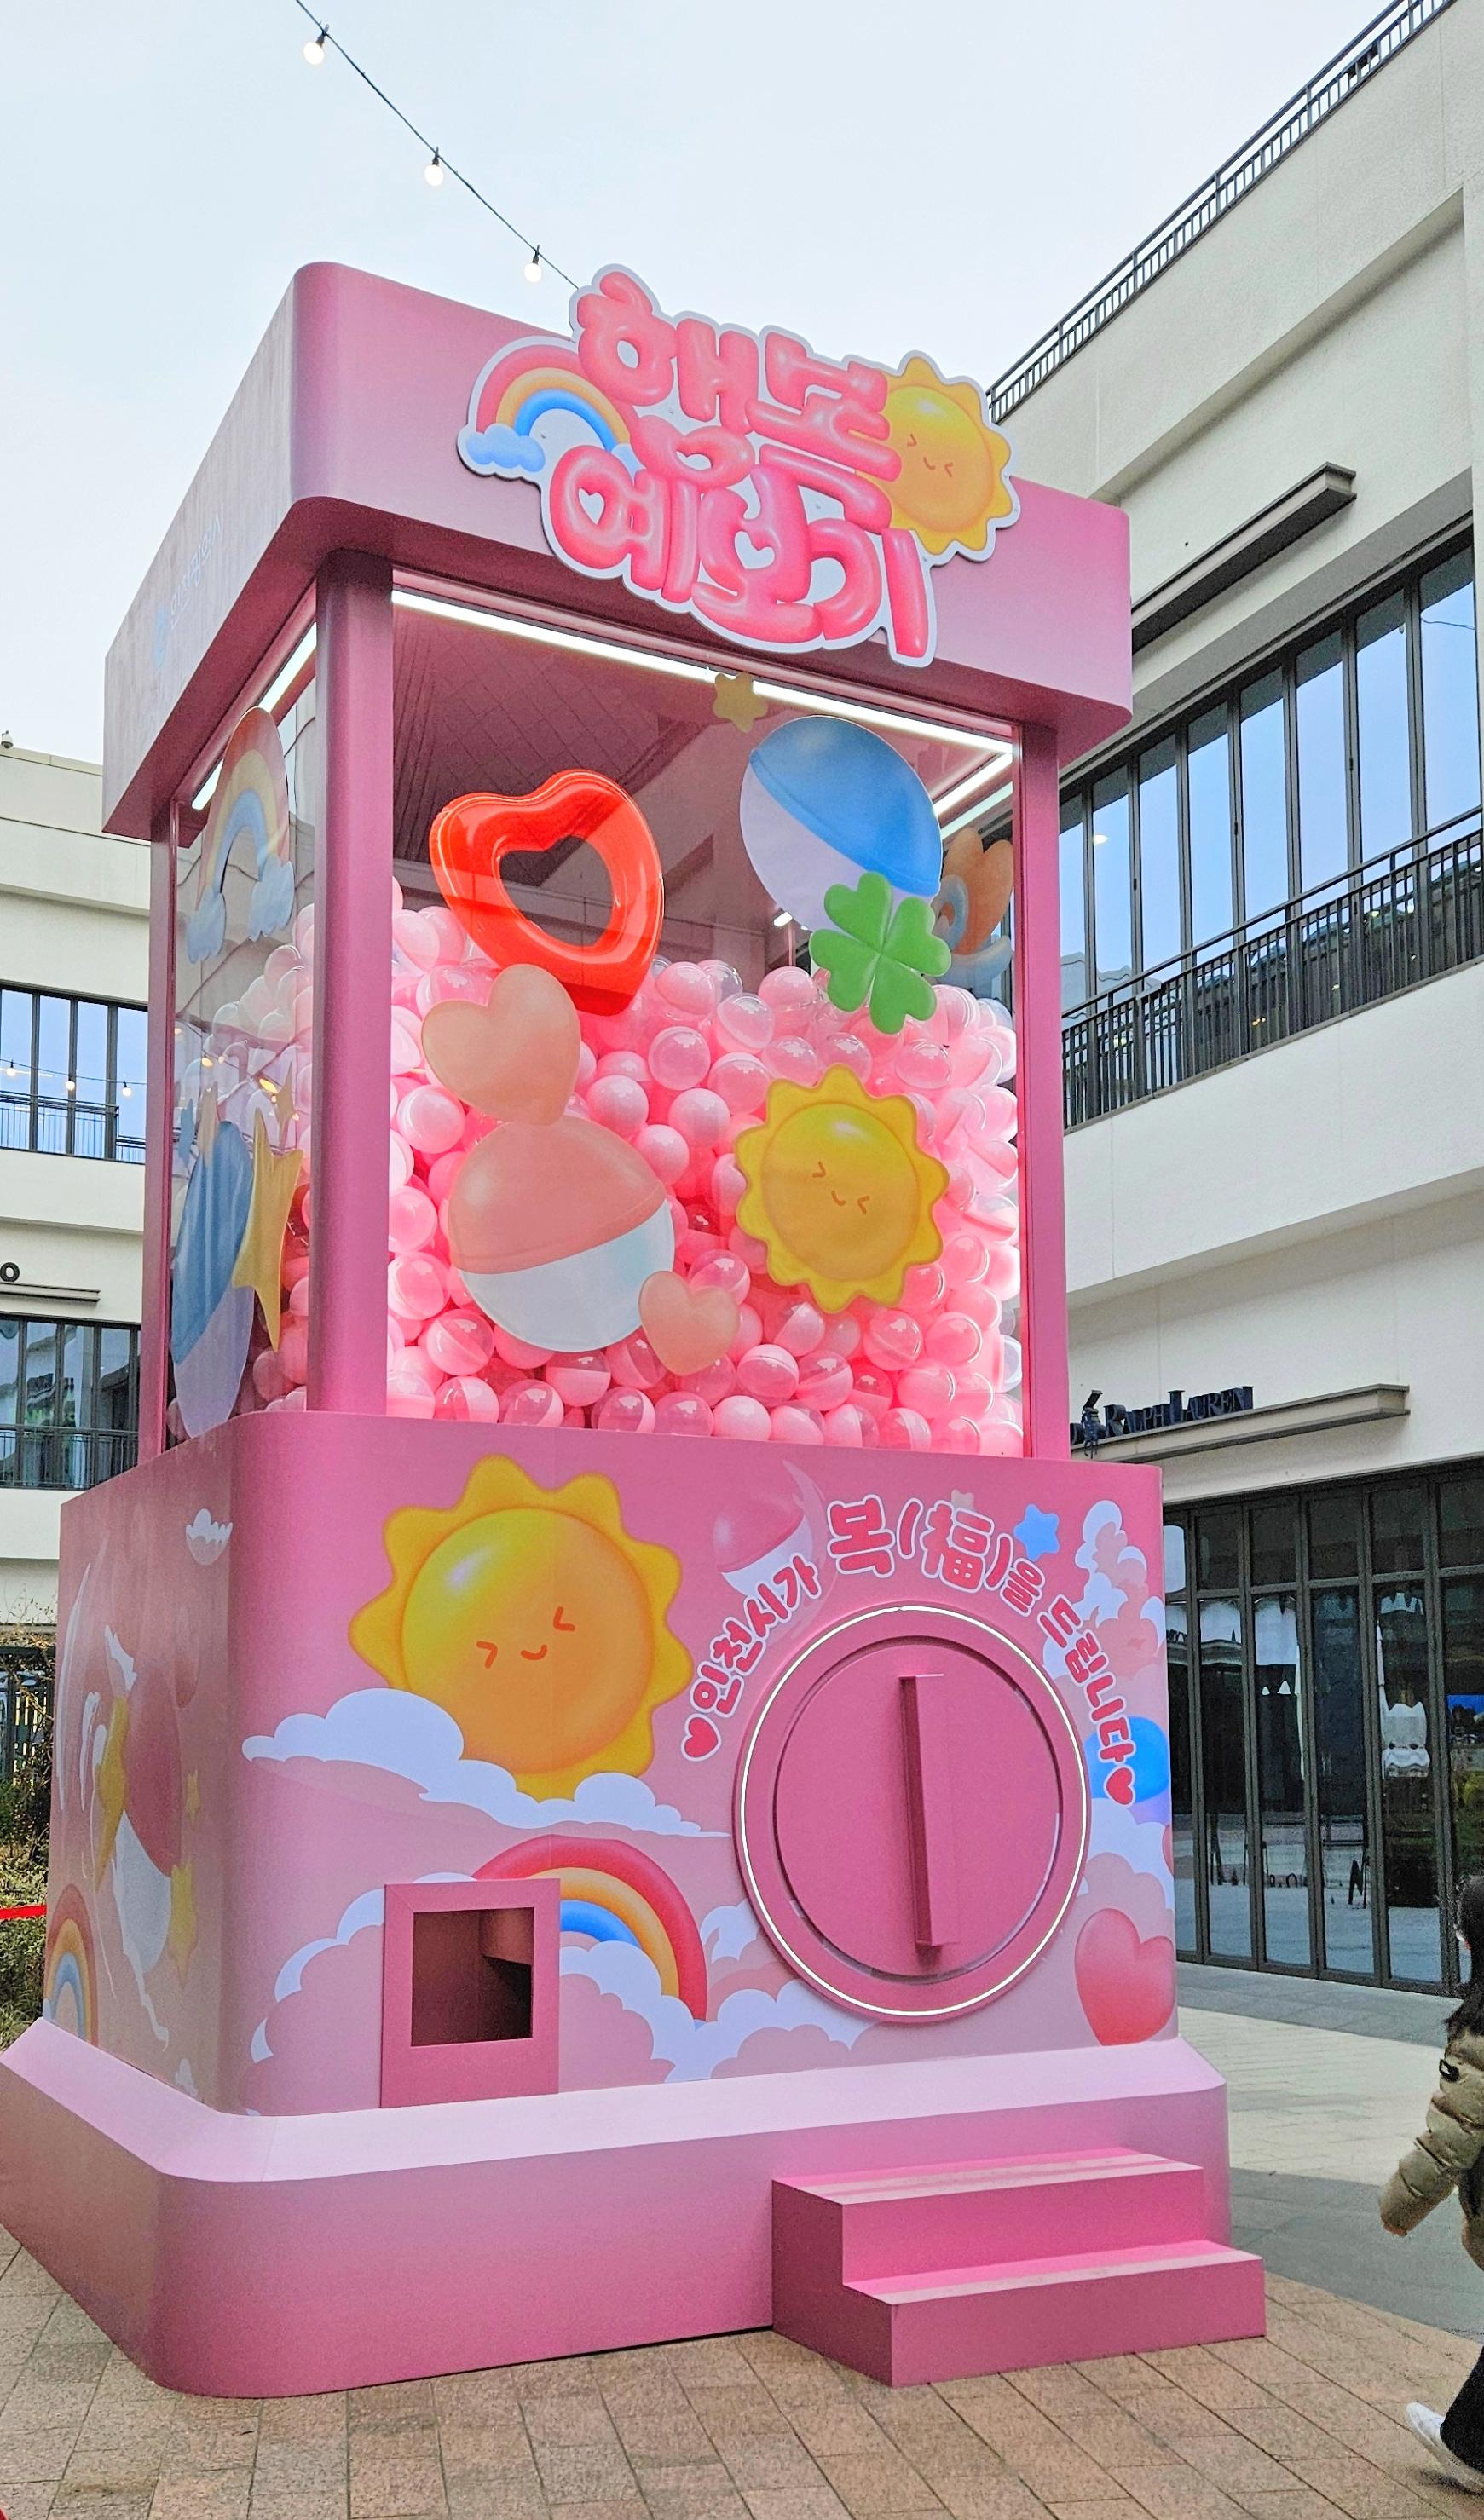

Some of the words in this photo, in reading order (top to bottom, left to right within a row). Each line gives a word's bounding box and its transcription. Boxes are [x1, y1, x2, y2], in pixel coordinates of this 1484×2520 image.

[1104, 1404, 1171, 1436] RALPH
[1168, 1386, 1254, 1425] LAUREN
[691, 1554, 820, 1716] 인천시가
[829, 1496, 1045, 1616] 복(福)을
[1038, 1595, 1135, 1763] 드립니다
